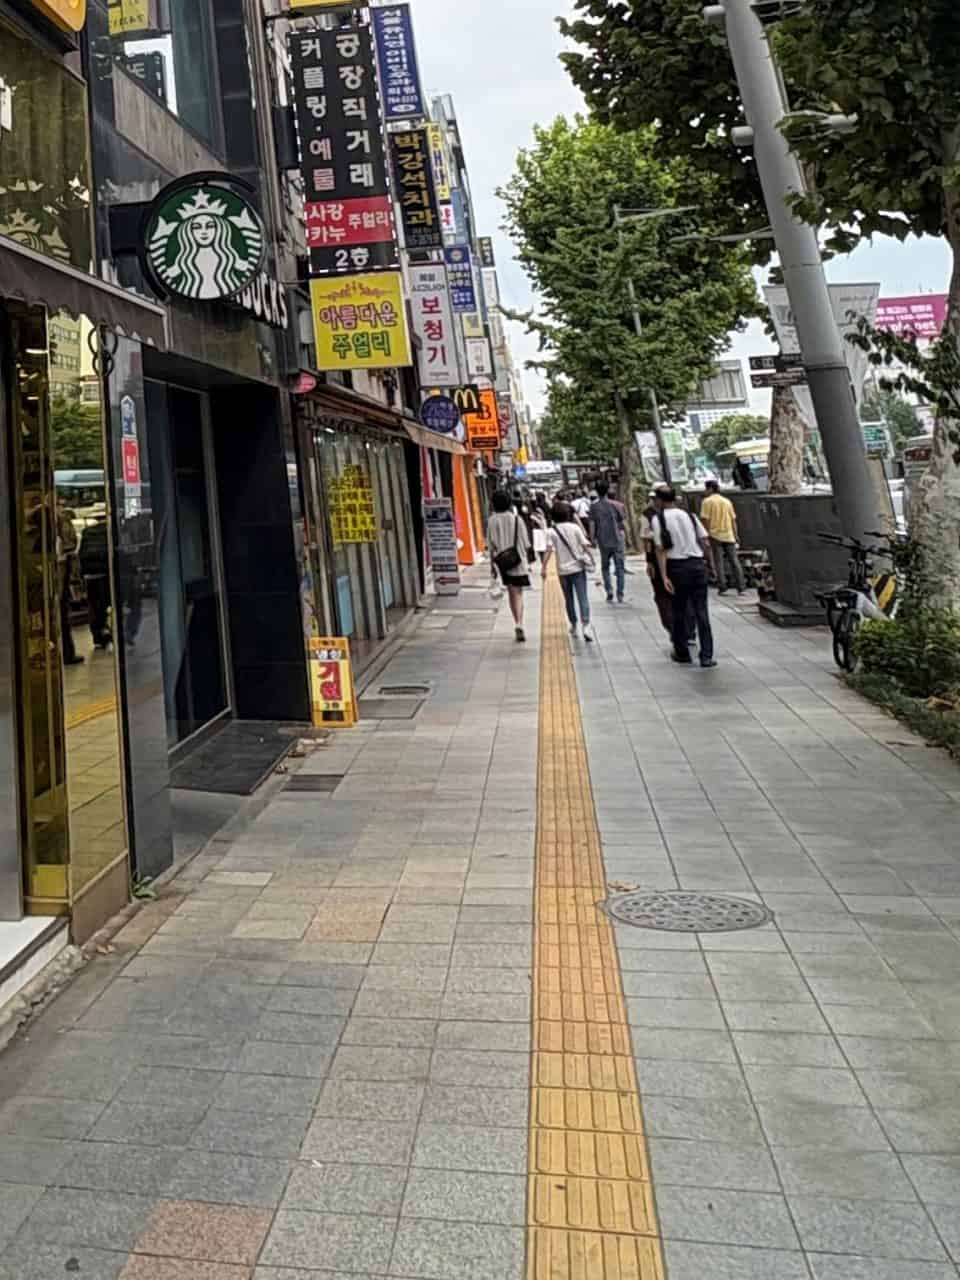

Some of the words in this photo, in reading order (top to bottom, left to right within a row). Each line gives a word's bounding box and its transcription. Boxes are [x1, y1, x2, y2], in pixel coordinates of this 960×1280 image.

[336, 33, 375, 188] 공장직거래
[348, 211, 390, 231] 주얼리
[335, 247, 369, 267] 2층
[320, 300, 398, 331] 아름다운
[332, 330, 390, 359] 주얼리
[422, 296, 446, 366] 보청기
